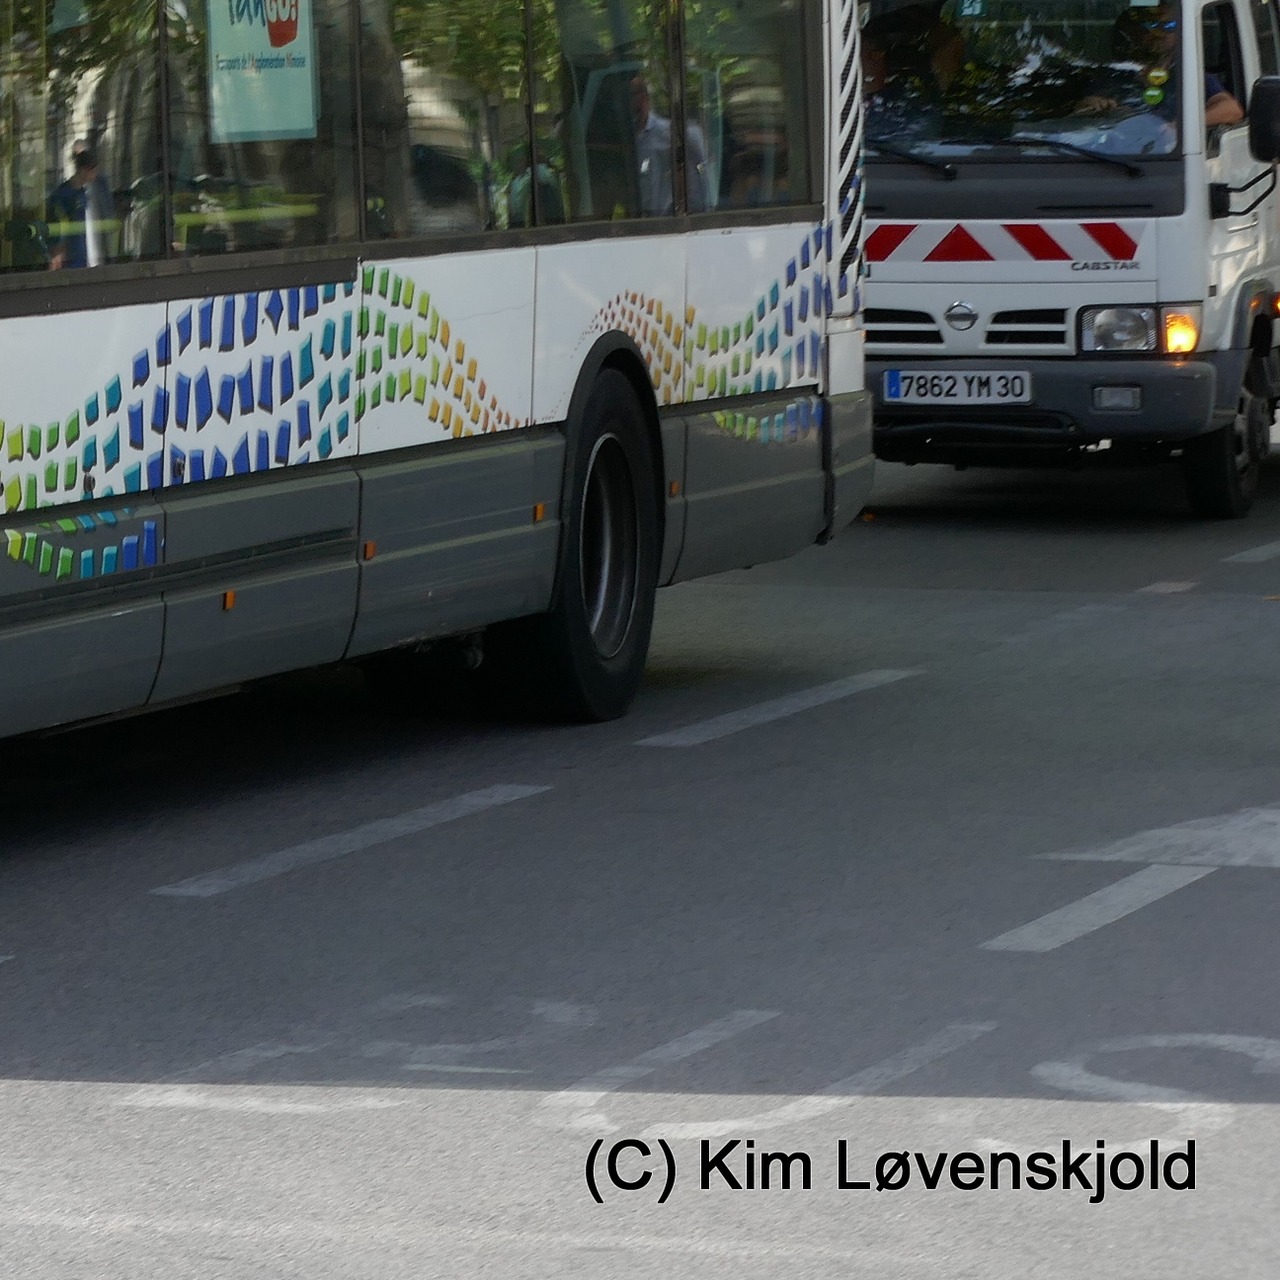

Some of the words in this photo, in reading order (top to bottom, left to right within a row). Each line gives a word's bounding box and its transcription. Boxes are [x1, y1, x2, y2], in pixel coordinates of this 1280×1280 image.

[1071, 261, 1140, 272] CABSTAR
[900, 375, 957, 399] 7862
[963, 376, 992, 399] YM
[998, 375, 1025, 399] 30
